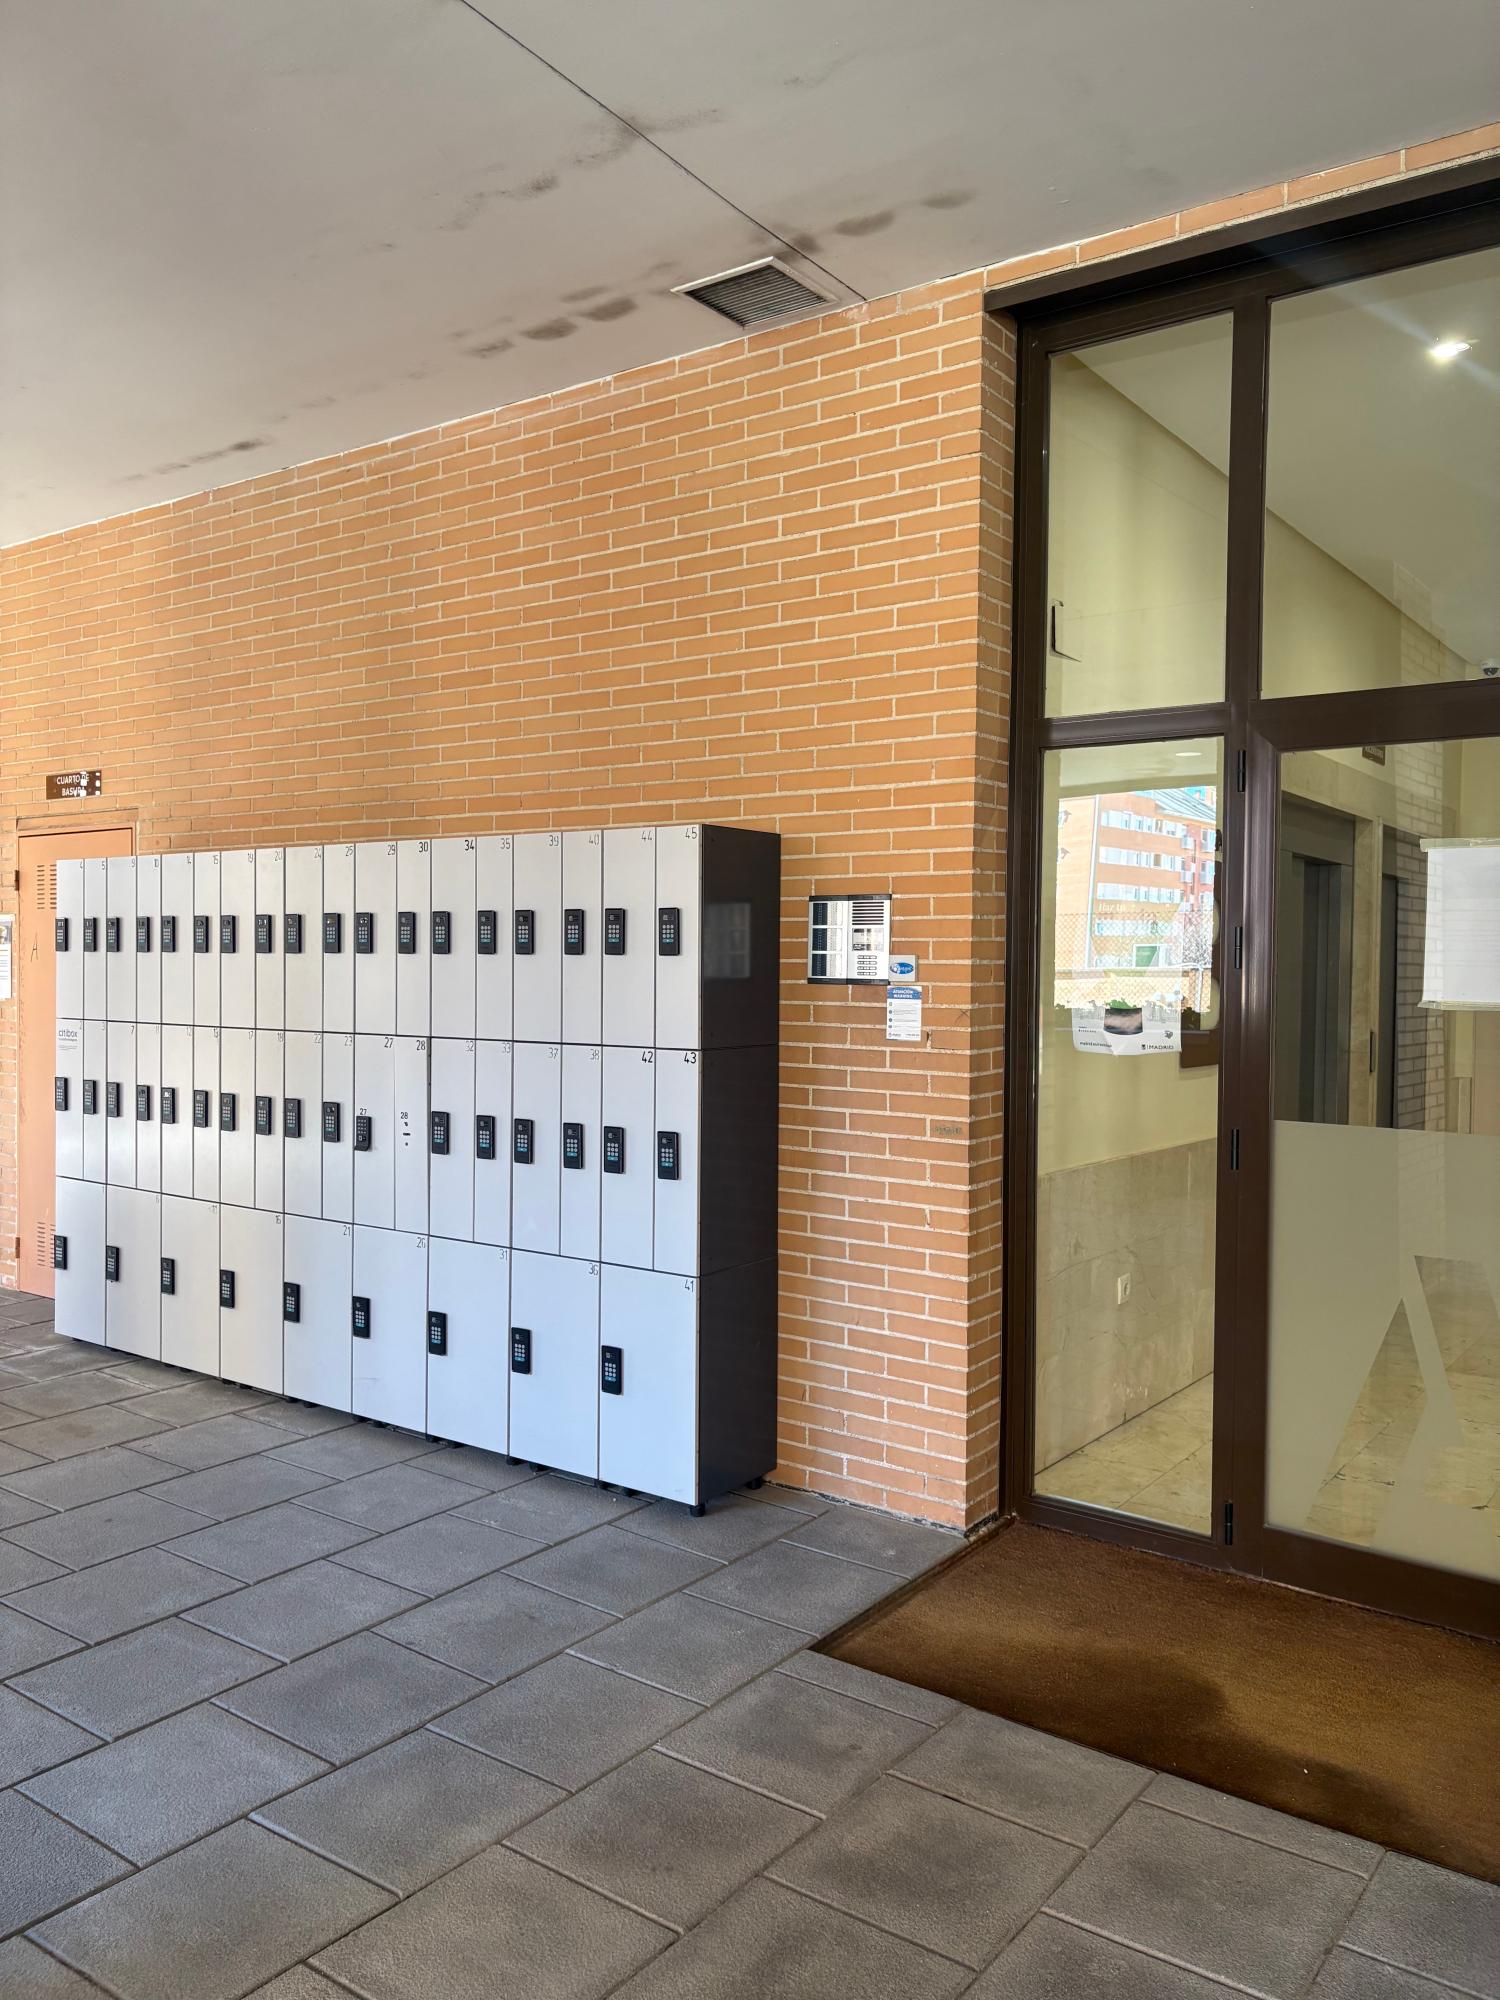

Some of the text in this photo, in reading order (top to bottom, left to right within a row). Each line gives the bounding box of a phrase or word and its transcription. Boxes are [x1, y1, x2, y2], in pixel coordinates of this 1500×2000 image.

[56, 774, 80, 785] CUARTO
[641, 830, 653, 841] 44
[684, 826, 698, 839] 45
[418, 841, 429, 853] 30
[464, 839, 475, 851] 34
[500, 837, 511, 850] 35
[548, 835, 560, 847] 39
[345, 845, 354, 857] 25
[387, 844, 396, 856] 29
[58, 1029, 78, 1038] citibox
[384, 1036, 394, 1049] 27
[416, 1039, 426, 1051] 28
[548, 1047, 559, 1060] 37
[641, 1050, 654, 1063] 42
[684, 1051, 697, 1064] 43
[359, 1108, 367, 1116] 27
[343, 1225, 351, 1237] 21
[416, 1237, 426, 1249] 26
[499, 1249, 508, 1261] 31
[588, 1263, 599, 1276] 36
[684, 1279, 694, 1293] 41
